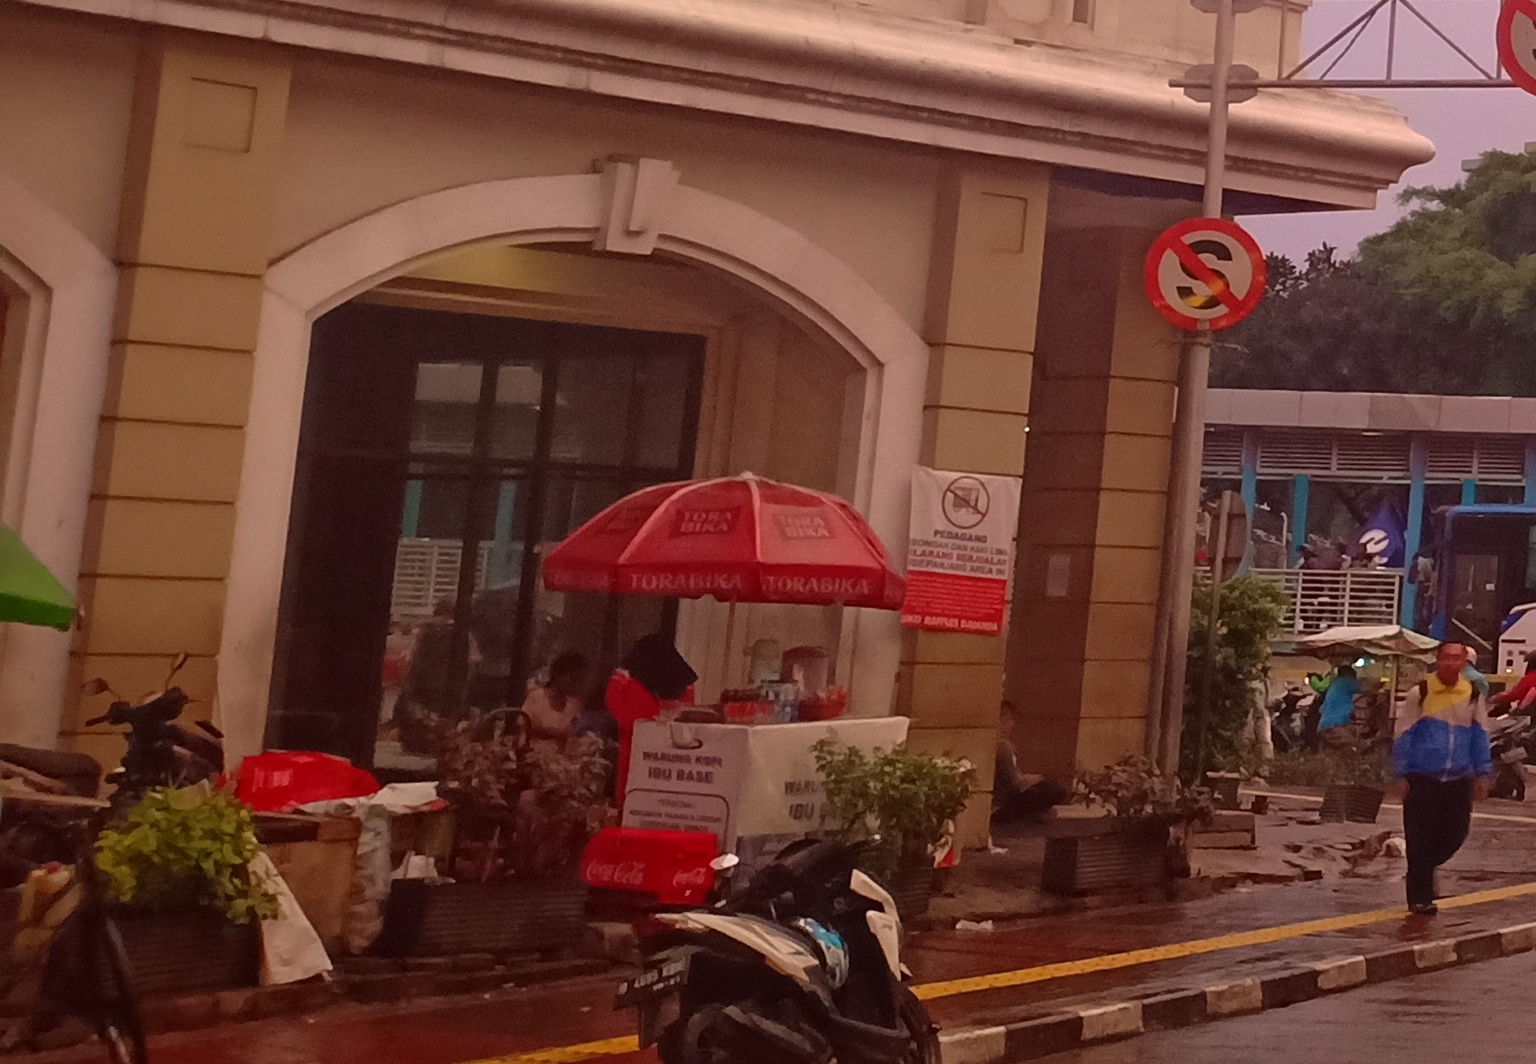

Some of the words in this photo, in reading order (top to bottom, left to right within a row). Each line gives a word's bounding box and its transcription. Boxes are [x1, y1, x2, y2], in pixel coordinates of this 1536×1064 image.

[681, 510, 732, 522] TORA
[933, 529, 988, 544] PEDAGANG
[630, 572, 742, 591] TORABIKA
[766, 575, 870, 595] TORABIKA
[647, 766, 672, 781] IBU
[676, 769, 714, 784] BASE
